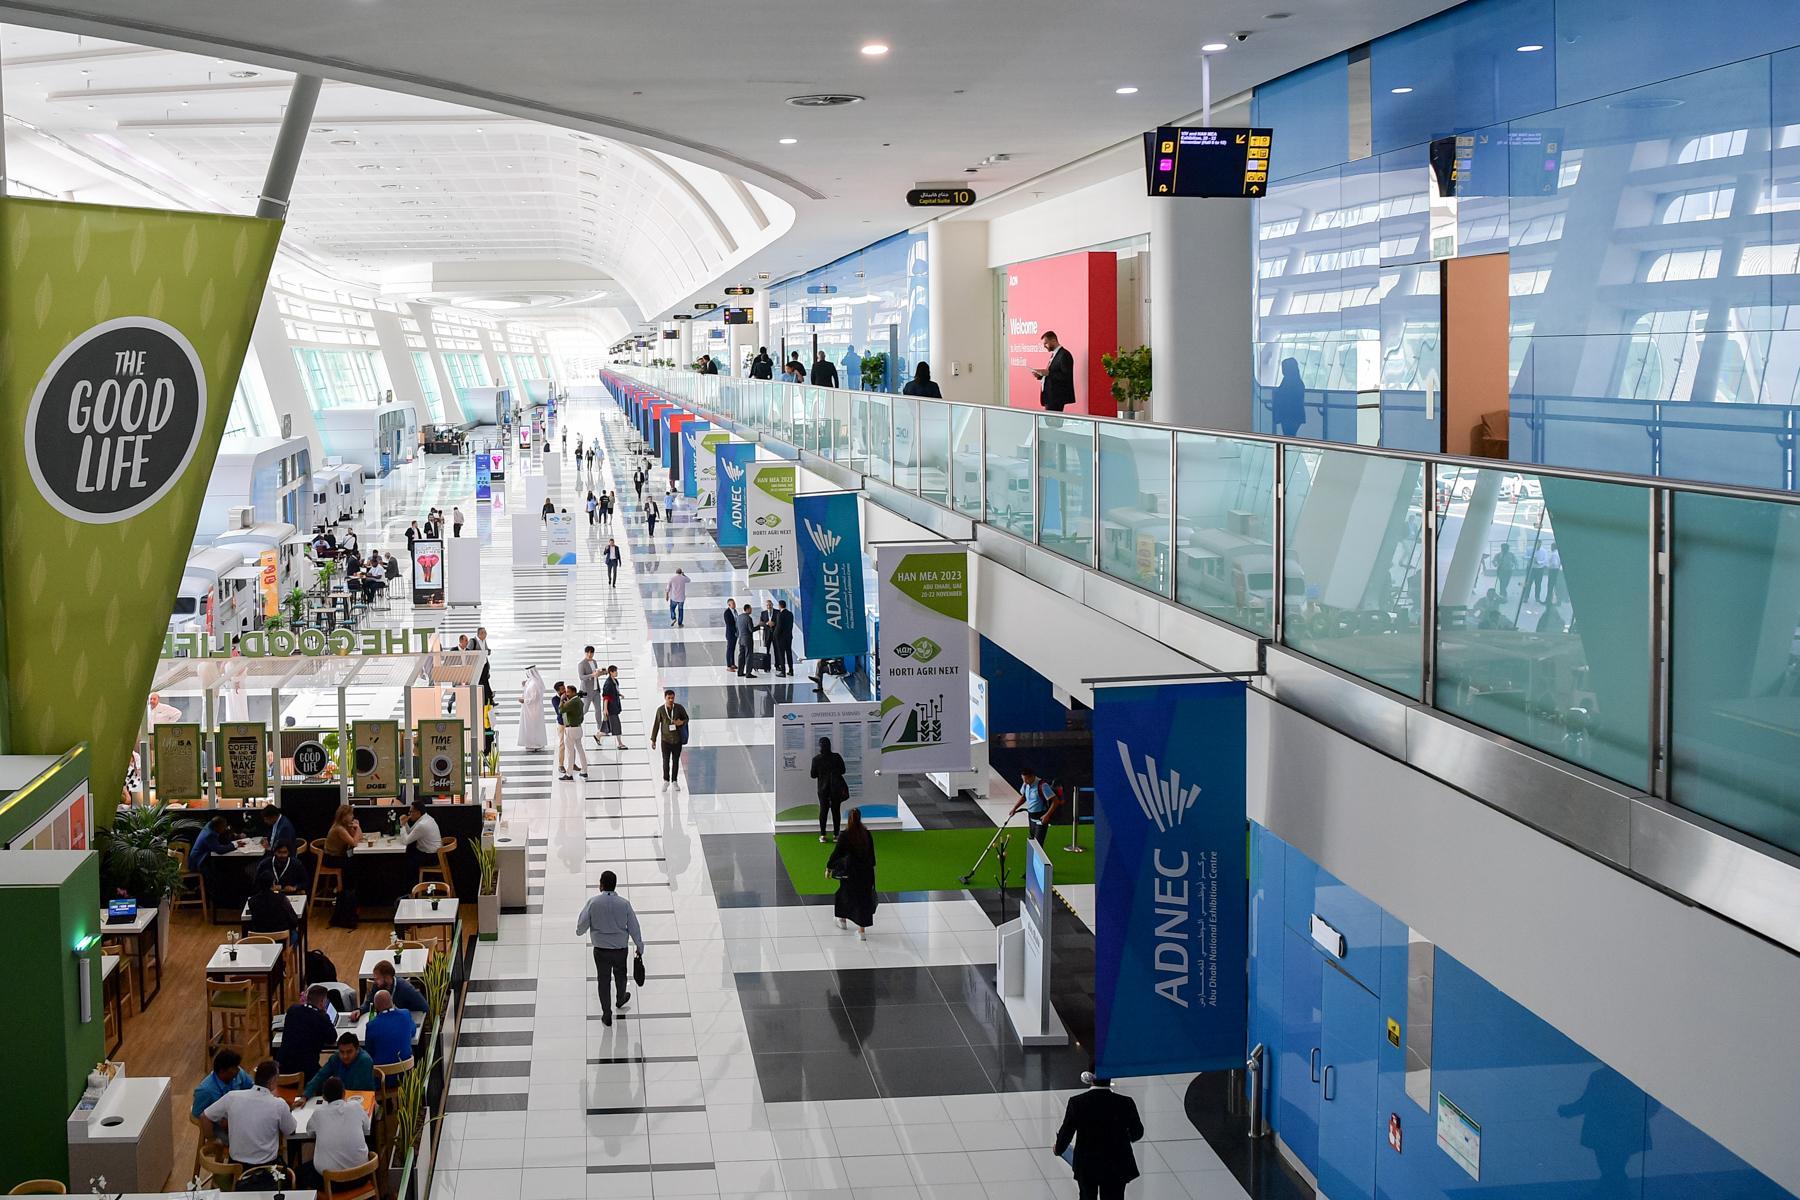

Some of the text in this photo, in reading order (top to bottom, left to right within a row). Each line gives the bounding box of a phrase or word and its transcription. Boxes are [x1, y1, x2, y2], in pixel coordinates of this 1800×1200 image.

[954, 192, 968, 203] 10
[1010, 318, 1038, 335] Welcome
[115, 350, 146, 376] THE
[68, 378, 175, 434] GOOD
[76, 435, 152, 492] LIFE
[732, 486, 742, 528] ADNEC
[898, 571, 961, 581] HAN MEA 2023
[822, 562, 842, 629] ADNEC
[890, 666, 958, 676] HORTI AGRI NEXT
[431, 736, 452, 744] TIME
[300, 752, 320, 762] GOOD
[231, 761, 255, 769] MAKE
[303, 762, 318, 772] LIFE
[234, 780, 253, 788] BLEND
[430, 778, 455, 787] Coffee
[1154, 848, 1189, 1008] ADNEC
[1209, 852, 1217, 1006] Abu Dhabi National Exhibition Centre
